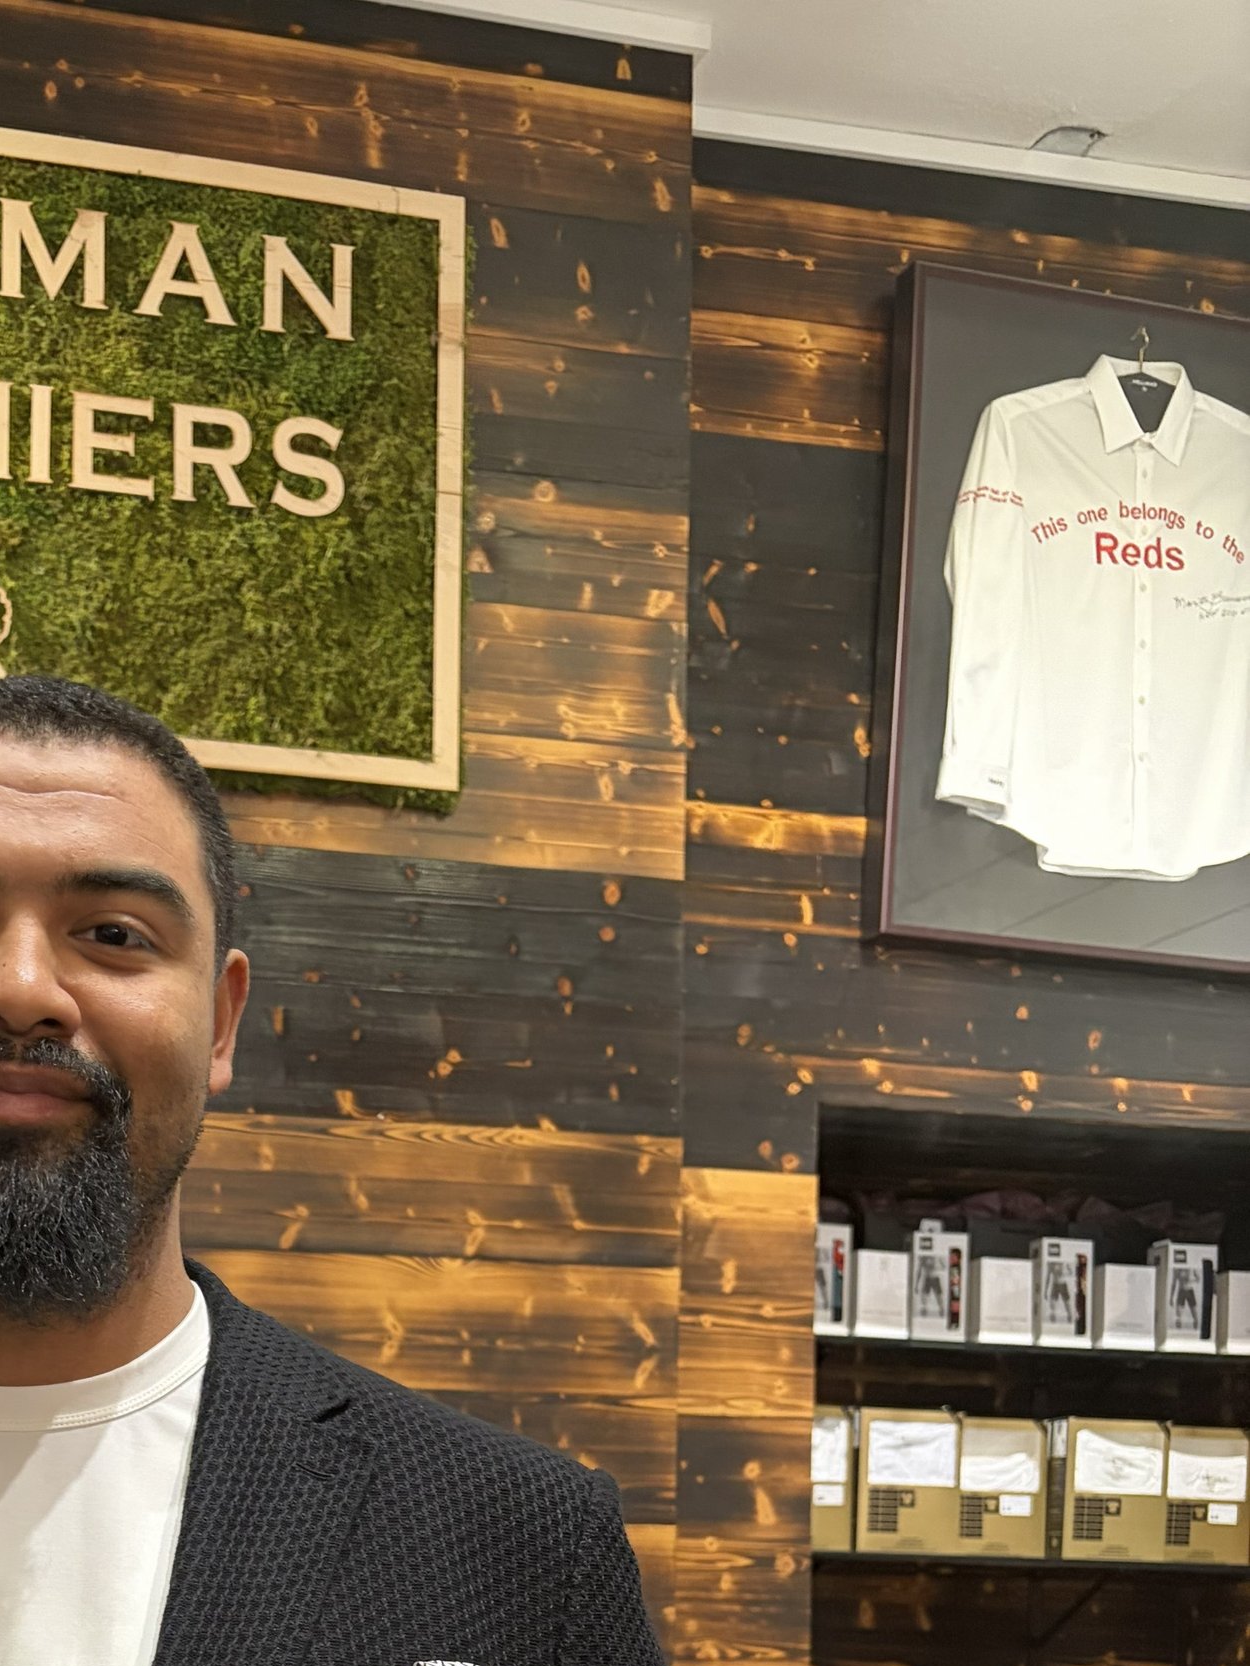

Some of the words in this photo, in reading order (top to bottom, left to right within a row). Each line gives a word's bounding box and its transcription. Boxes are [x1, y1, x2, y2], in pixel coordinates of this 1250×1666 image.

[1031, 516, 1068, 544] This
[1077, 507, 1108, 525] one
[1119, 500, 1185, 530] belongs
[1196, 520, 1214, 540] to
[1222, 534, 1245, 564] the
[1095, 532, 1185, 571] Reds
